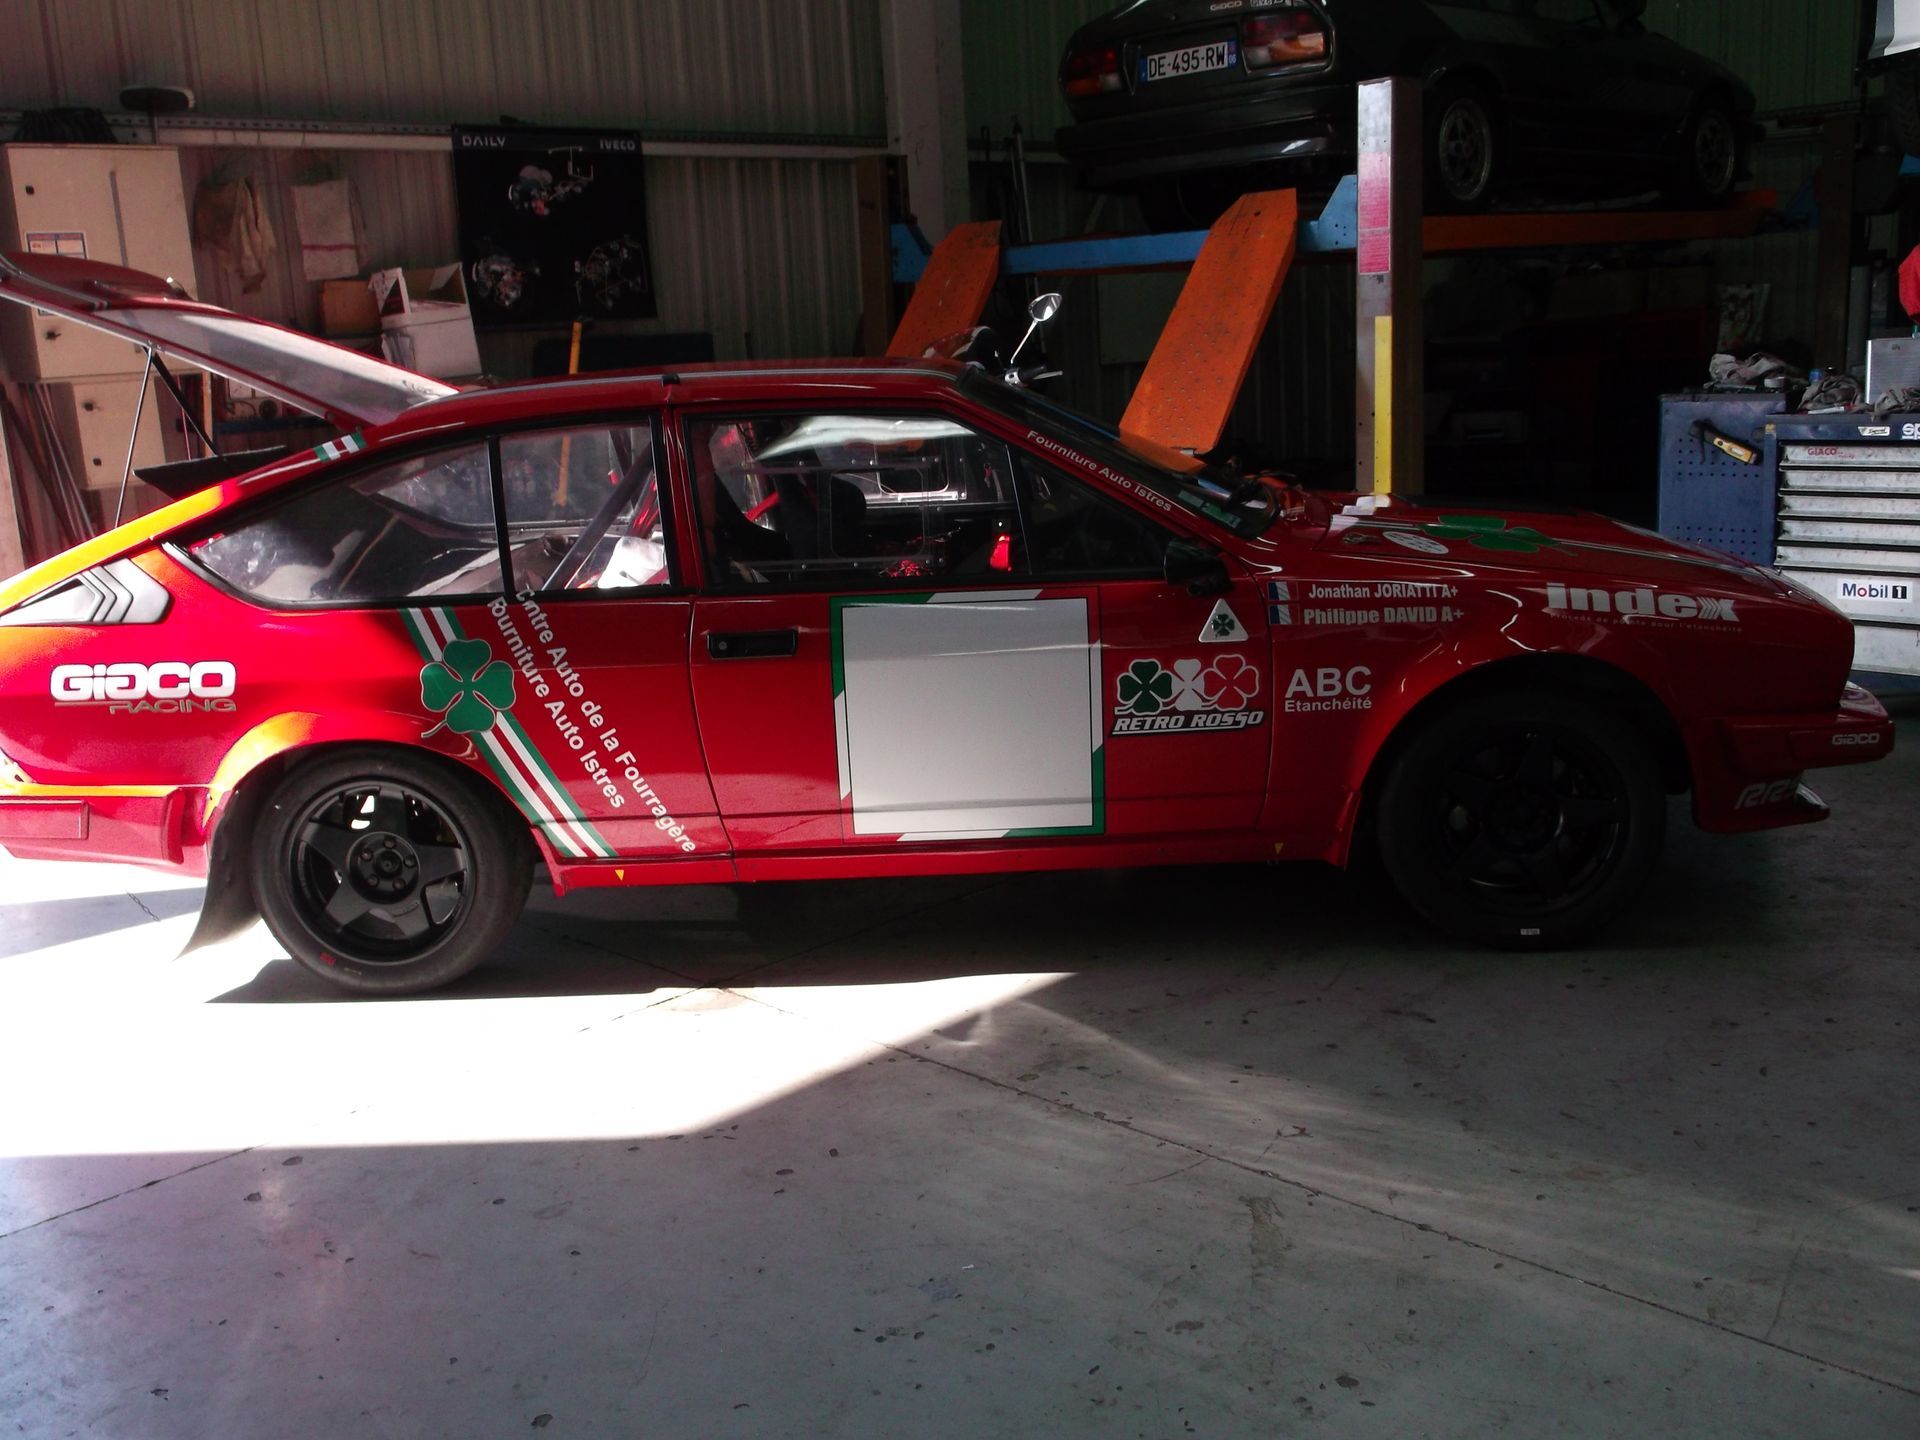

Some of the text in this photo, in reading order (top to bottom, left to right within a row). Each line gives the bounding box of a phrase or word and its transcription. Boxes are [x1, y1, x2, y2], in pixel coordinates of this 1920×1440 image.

[1149, 44, 1226, 78] DE-495-RW
[462, 135, 506, 147] DAILY
[600, 139, 636, 151] IVECO
[1026, 430, 1172, 512] Fourniture Auto Istres
[1308, 583, 1370, 599] Jonathan
[1441, 584, 1458, 598] A+
[1842, 583, 1907, 599] Mobil 1
[1303, 606, 1464, 626] Philippe DAVID A+
[1284, 665, 1372, 698] ABC
[109, 699, 237, 715] RACING
[487, 595, 625, 808] Fourniture Auto Istres
[1284, 697, 1373, 712] Etanchéité
[516, 588, 696, 852] Cntre Auto de la Fourragère
[1113, 711, 1265, 732] RETRO ROSSO
